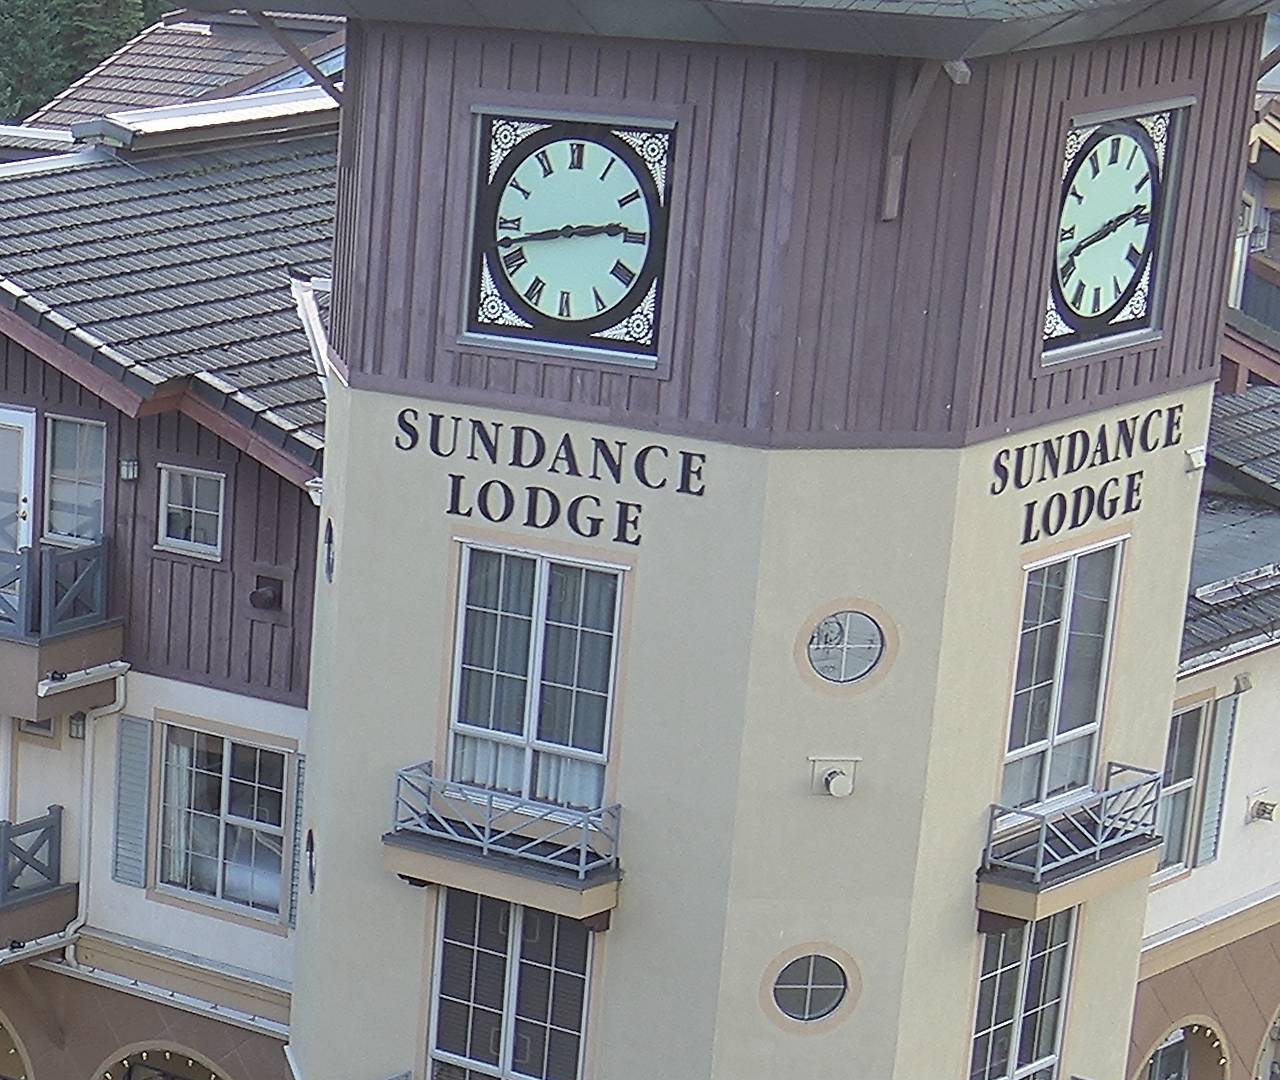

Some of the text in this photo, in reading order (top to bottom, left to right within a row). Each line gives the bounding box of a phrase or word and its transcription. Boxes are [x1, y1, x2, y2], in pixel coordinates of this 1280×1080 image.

[535, 151, 553, 178] XI
[569, 143, 585, 170] XII
[600, 157, 615, 181] I
[1126, 146, 1138, 170] I
[510, 178, 530, 200] X
[618, 189, 641, 207] II
[499, 217, 522, 231] IX
[1060, 224, 1075, 241] IX
[623, 230, 646, 245] III
[503, 247, 528, 277] VIII
[524, 276, 546, 306] VII
[558, 291, 570, 317] VI
[593, 287, 606, 312] V
[394, 407, 708, 497] SUNDANCE
[991, 403, 1184, 496] SUNDANCE
[445, 473, 643, 546] LODGE
[1020, 470, 1145, 546] LODGE
